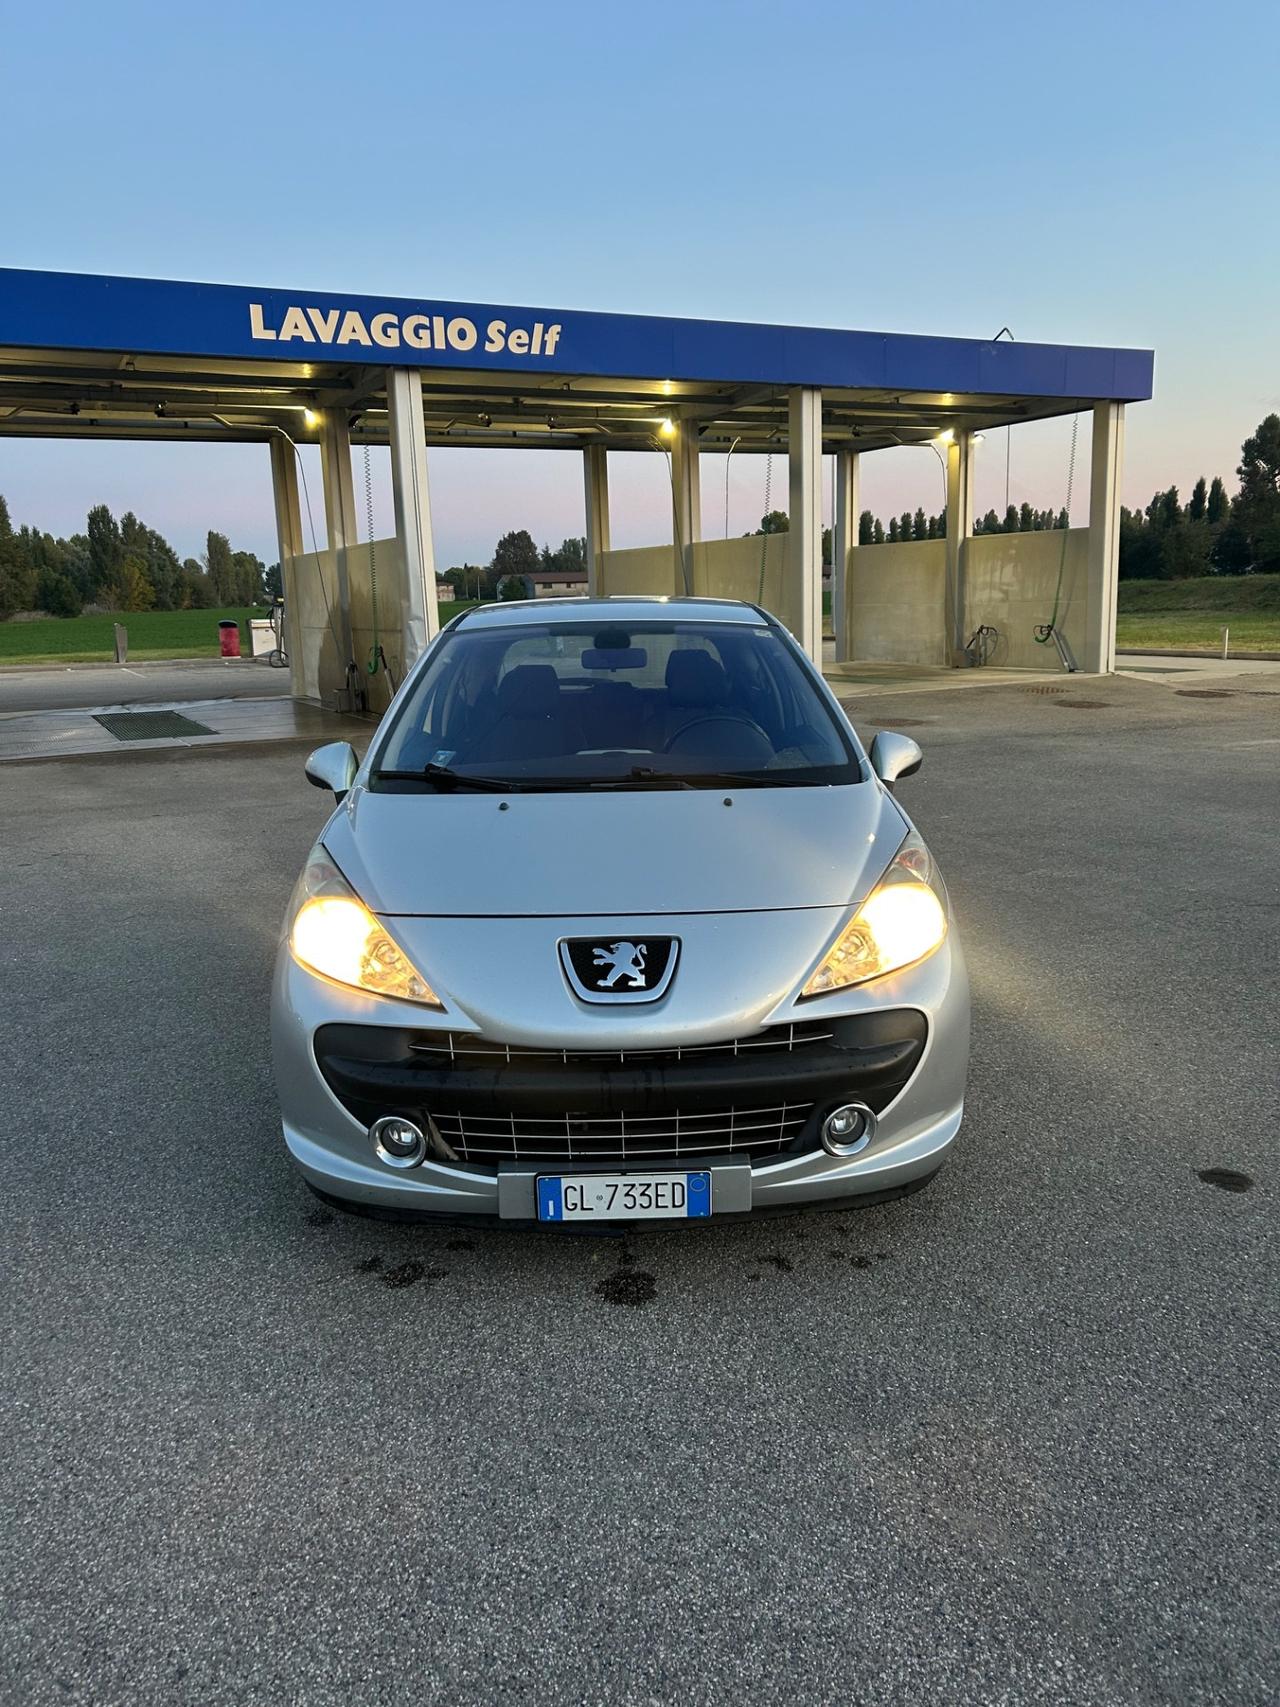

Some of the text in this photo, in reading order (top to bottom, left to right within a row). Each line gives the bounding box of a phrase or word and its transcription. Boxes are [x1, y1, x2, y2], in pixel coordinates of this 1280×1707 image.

[249, 303, 562, 355] LAVAGGIO Self
[564, 1182, 685, 1211] GL 733ED
